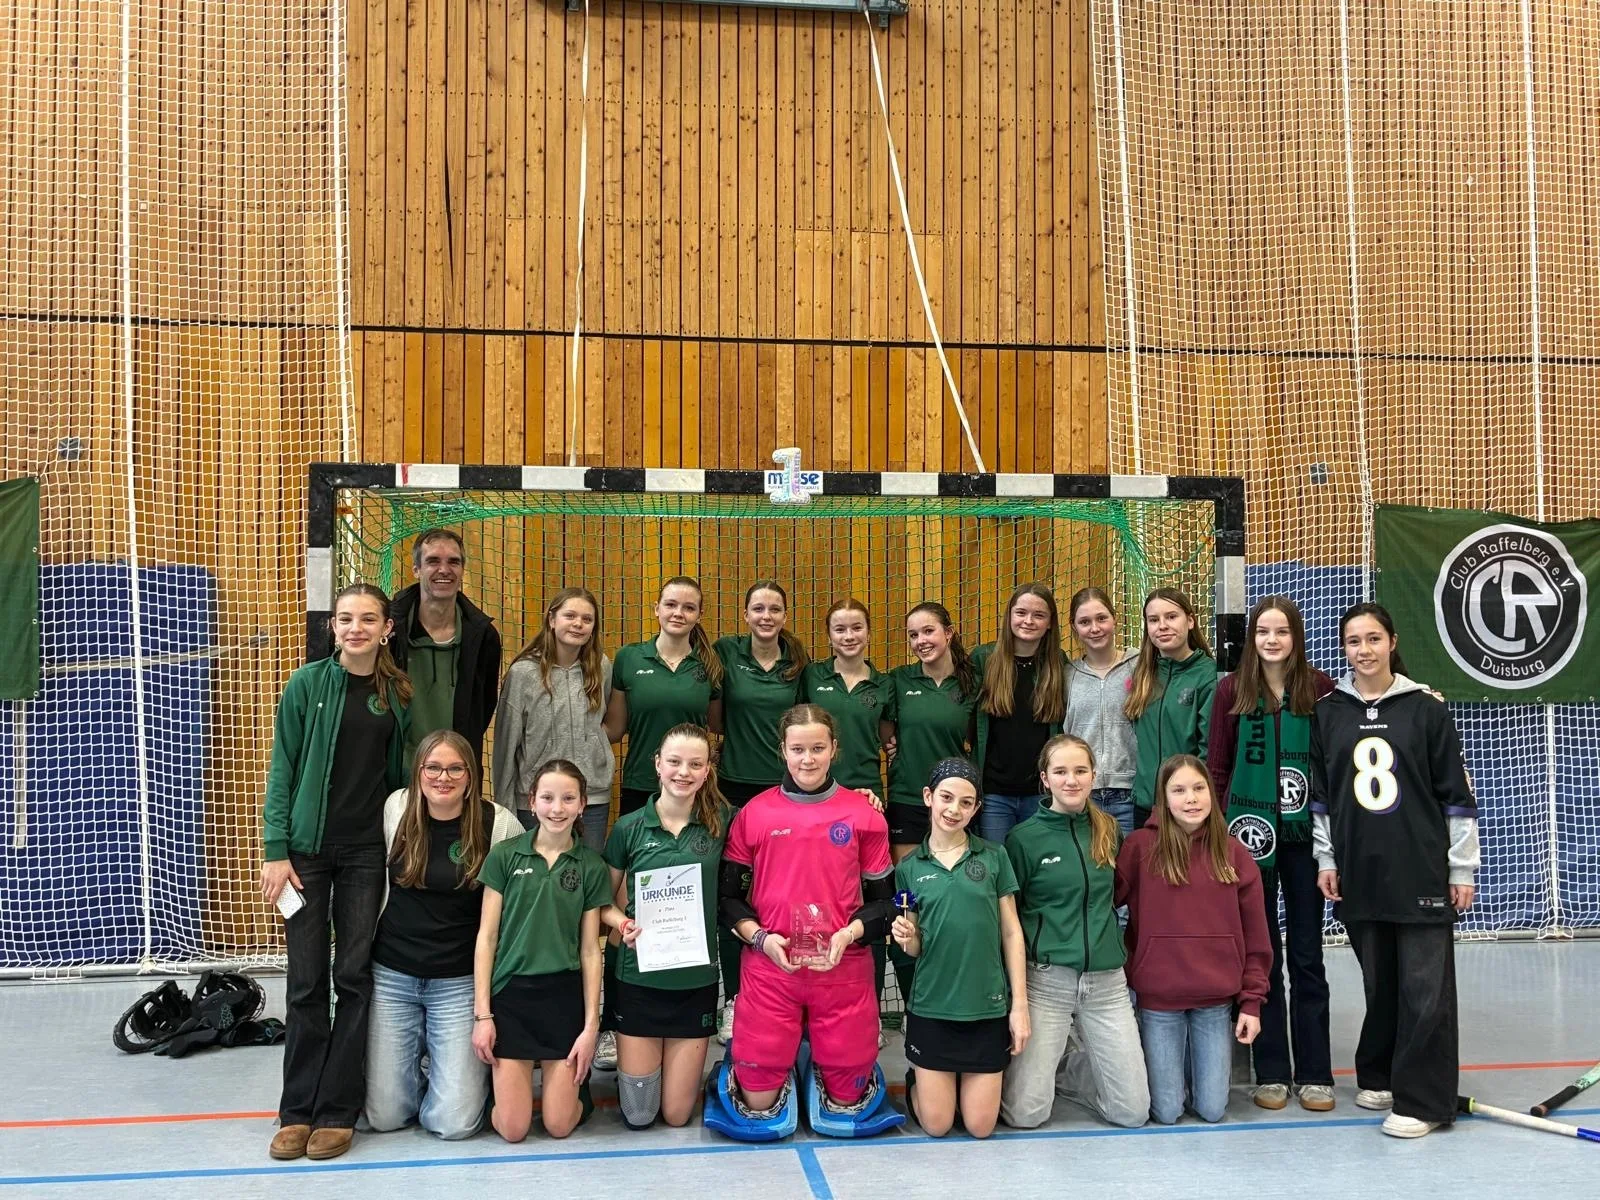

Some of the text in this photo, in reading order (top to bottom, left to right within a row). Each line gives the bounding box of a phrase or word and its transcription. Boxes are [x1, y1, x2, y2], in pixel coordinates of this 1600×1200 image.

[1450, 556, 1478, 590] Club
[1477, 536, 1551, 568] Raffelberg
[1480, 655, 1546, 677] Duisburg
[1353, 736, 1401, 813] 8
[1231, 793, 1277, 814] Duisburg
[642, 884, 695, 901] URKUNDE
[900, 893, 909, 908] 1
